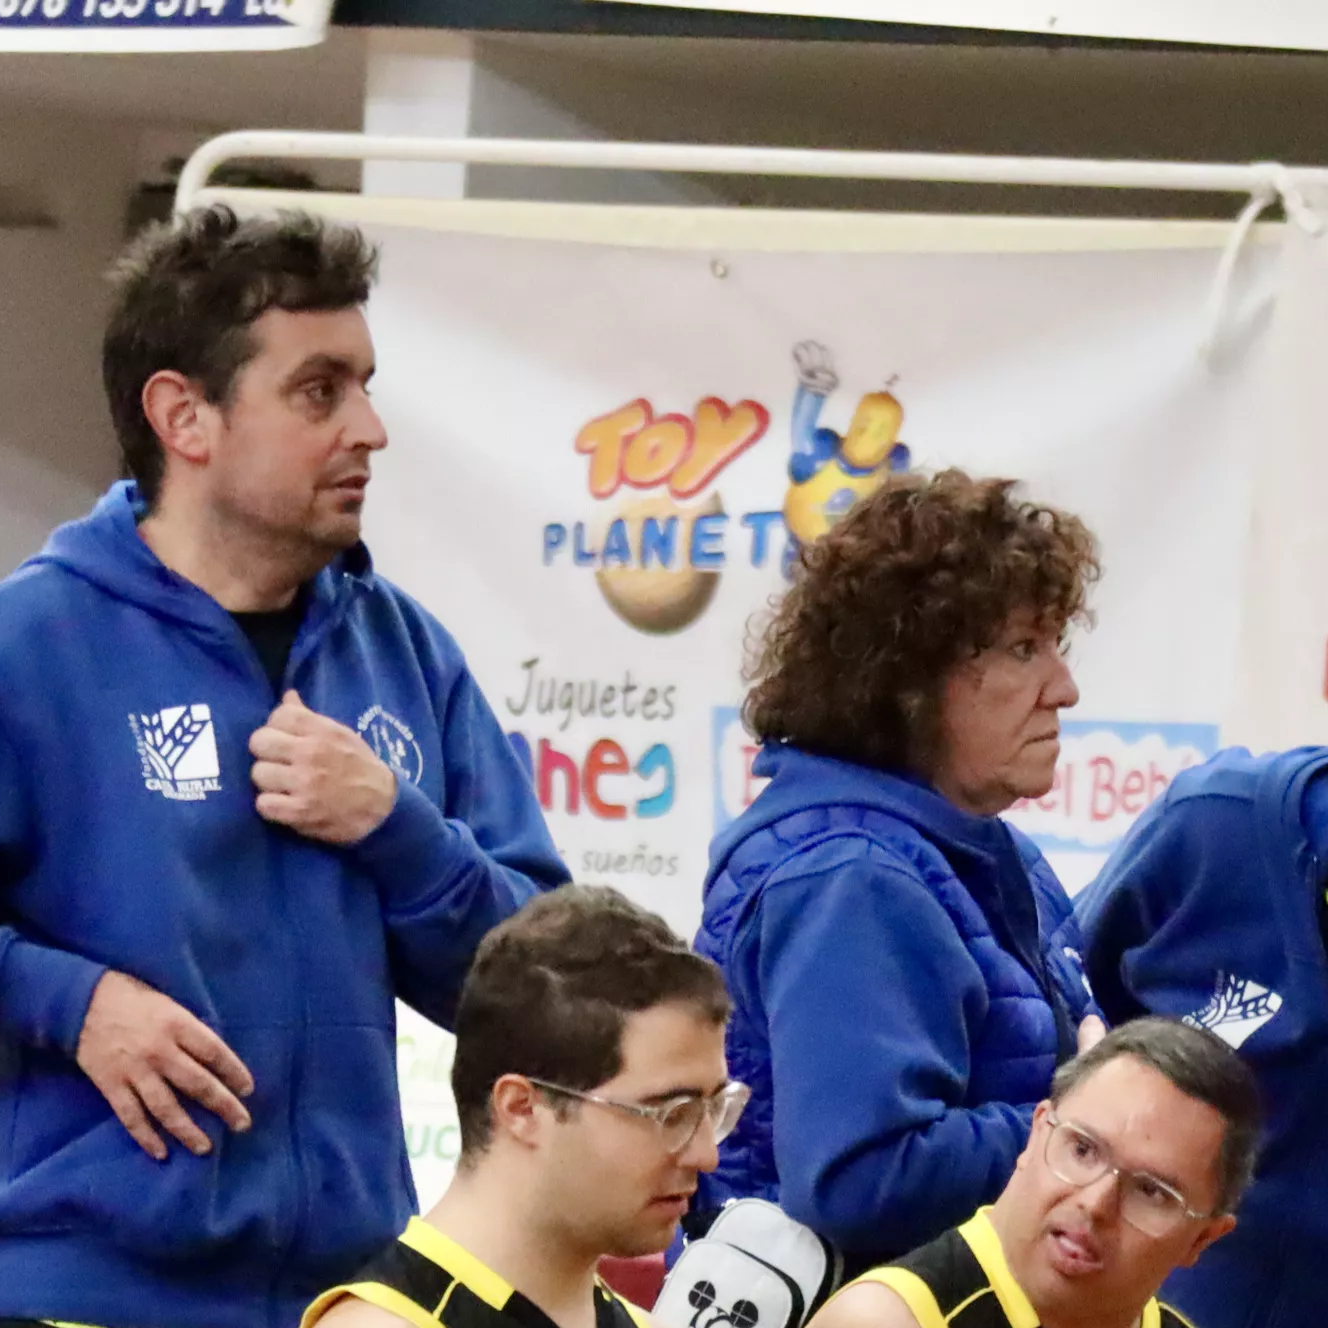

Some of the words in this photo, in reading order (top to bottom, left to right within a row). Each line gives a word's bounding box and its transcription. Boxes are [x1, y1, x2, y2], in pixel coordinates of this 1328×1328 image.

[574, 396, 770, 500] TOY
[542, 510, 784, 570] PLANET
[505, 656, 677, 732] Juguetes
[581, 843, 680, 878] sueños
